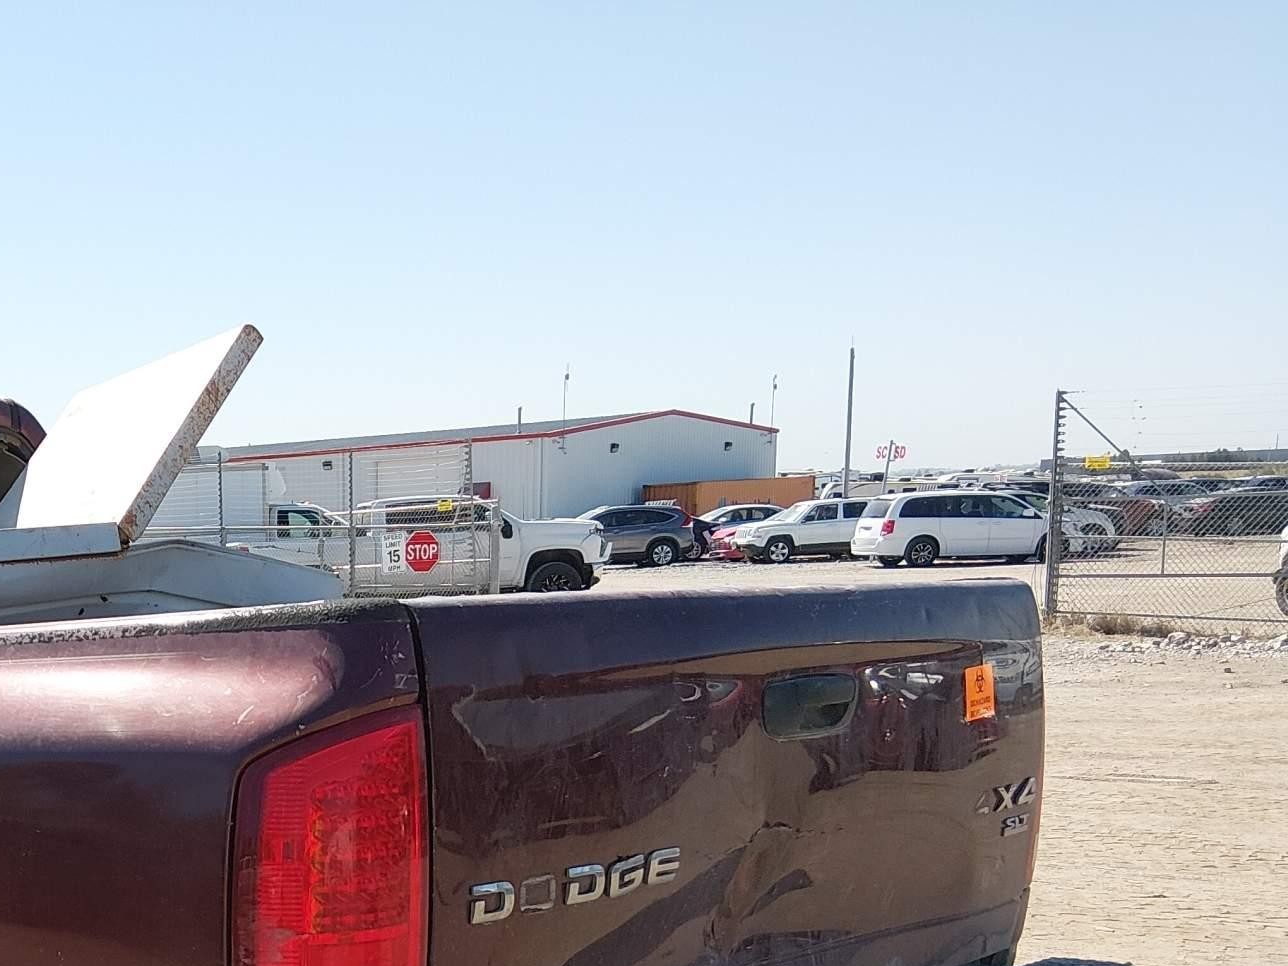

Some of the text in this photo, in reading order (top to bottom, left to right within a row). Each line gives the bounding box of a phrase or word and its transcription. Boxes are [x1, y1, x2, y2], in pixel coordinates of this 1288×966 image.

[387, 549, 401, 563] 15
[406, 543, 438, 560] STOP
[1000, 813, 1030, 837] SLT
